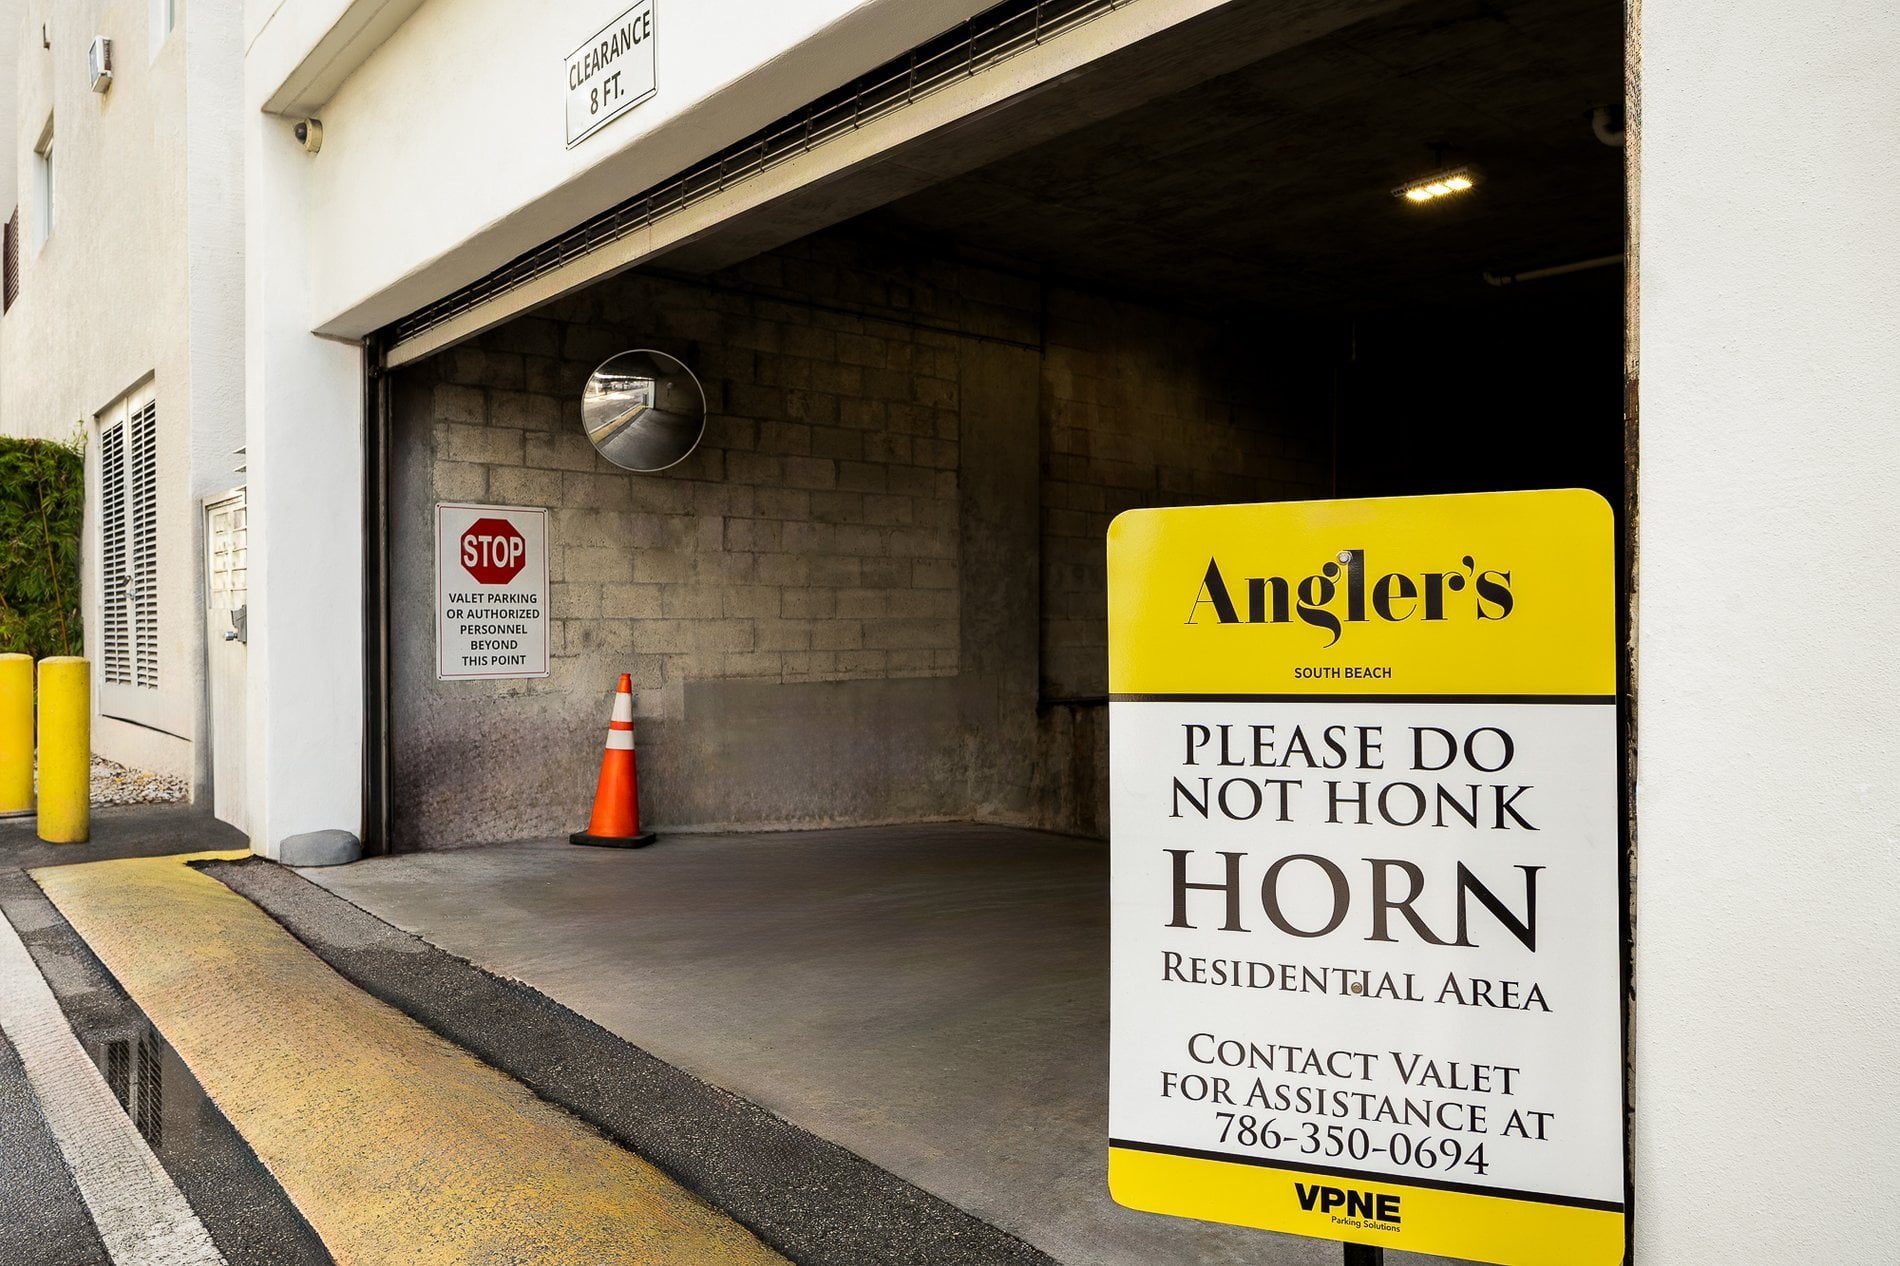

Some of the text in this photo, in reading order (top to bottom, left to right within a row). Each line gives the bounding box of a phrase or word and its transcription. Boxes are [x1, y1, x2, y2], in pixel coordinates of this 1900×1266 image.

[569, 10, 650, 91] CLEARANCE
[591, 71, 624, 115] 8 FT.
[463, 535, 523, 568] STOP
[447, 609, 540, 619] OR AUTHORIZED
[449, 593, 537, 604] VALET PARKING
[1184, 549, 1514, 648] Angler's
[461, 625, 528, 634] PERSONNEL
[471, 640, 518, 650] BEYOND
[462, 655, 526, 666] THIS POINT
[1294, 667, 1392, 679] SOUTH BEACH
[1181, 724, 1515, 772] PLEASE DO
[1169, 776, 1540, 831] NOT HONK
[1162, 849, 1546, 952] HORN
[1161, 1071, 1234, 1105] FOR
[1500, 1109, 1554, 1141] AT
[1215, 1112, 1489, 1175] 786-350-0694
[1294, 1183, 1401, 1223] VPNE
[1331, 1215, 1401, 1232] Parking Solutions
